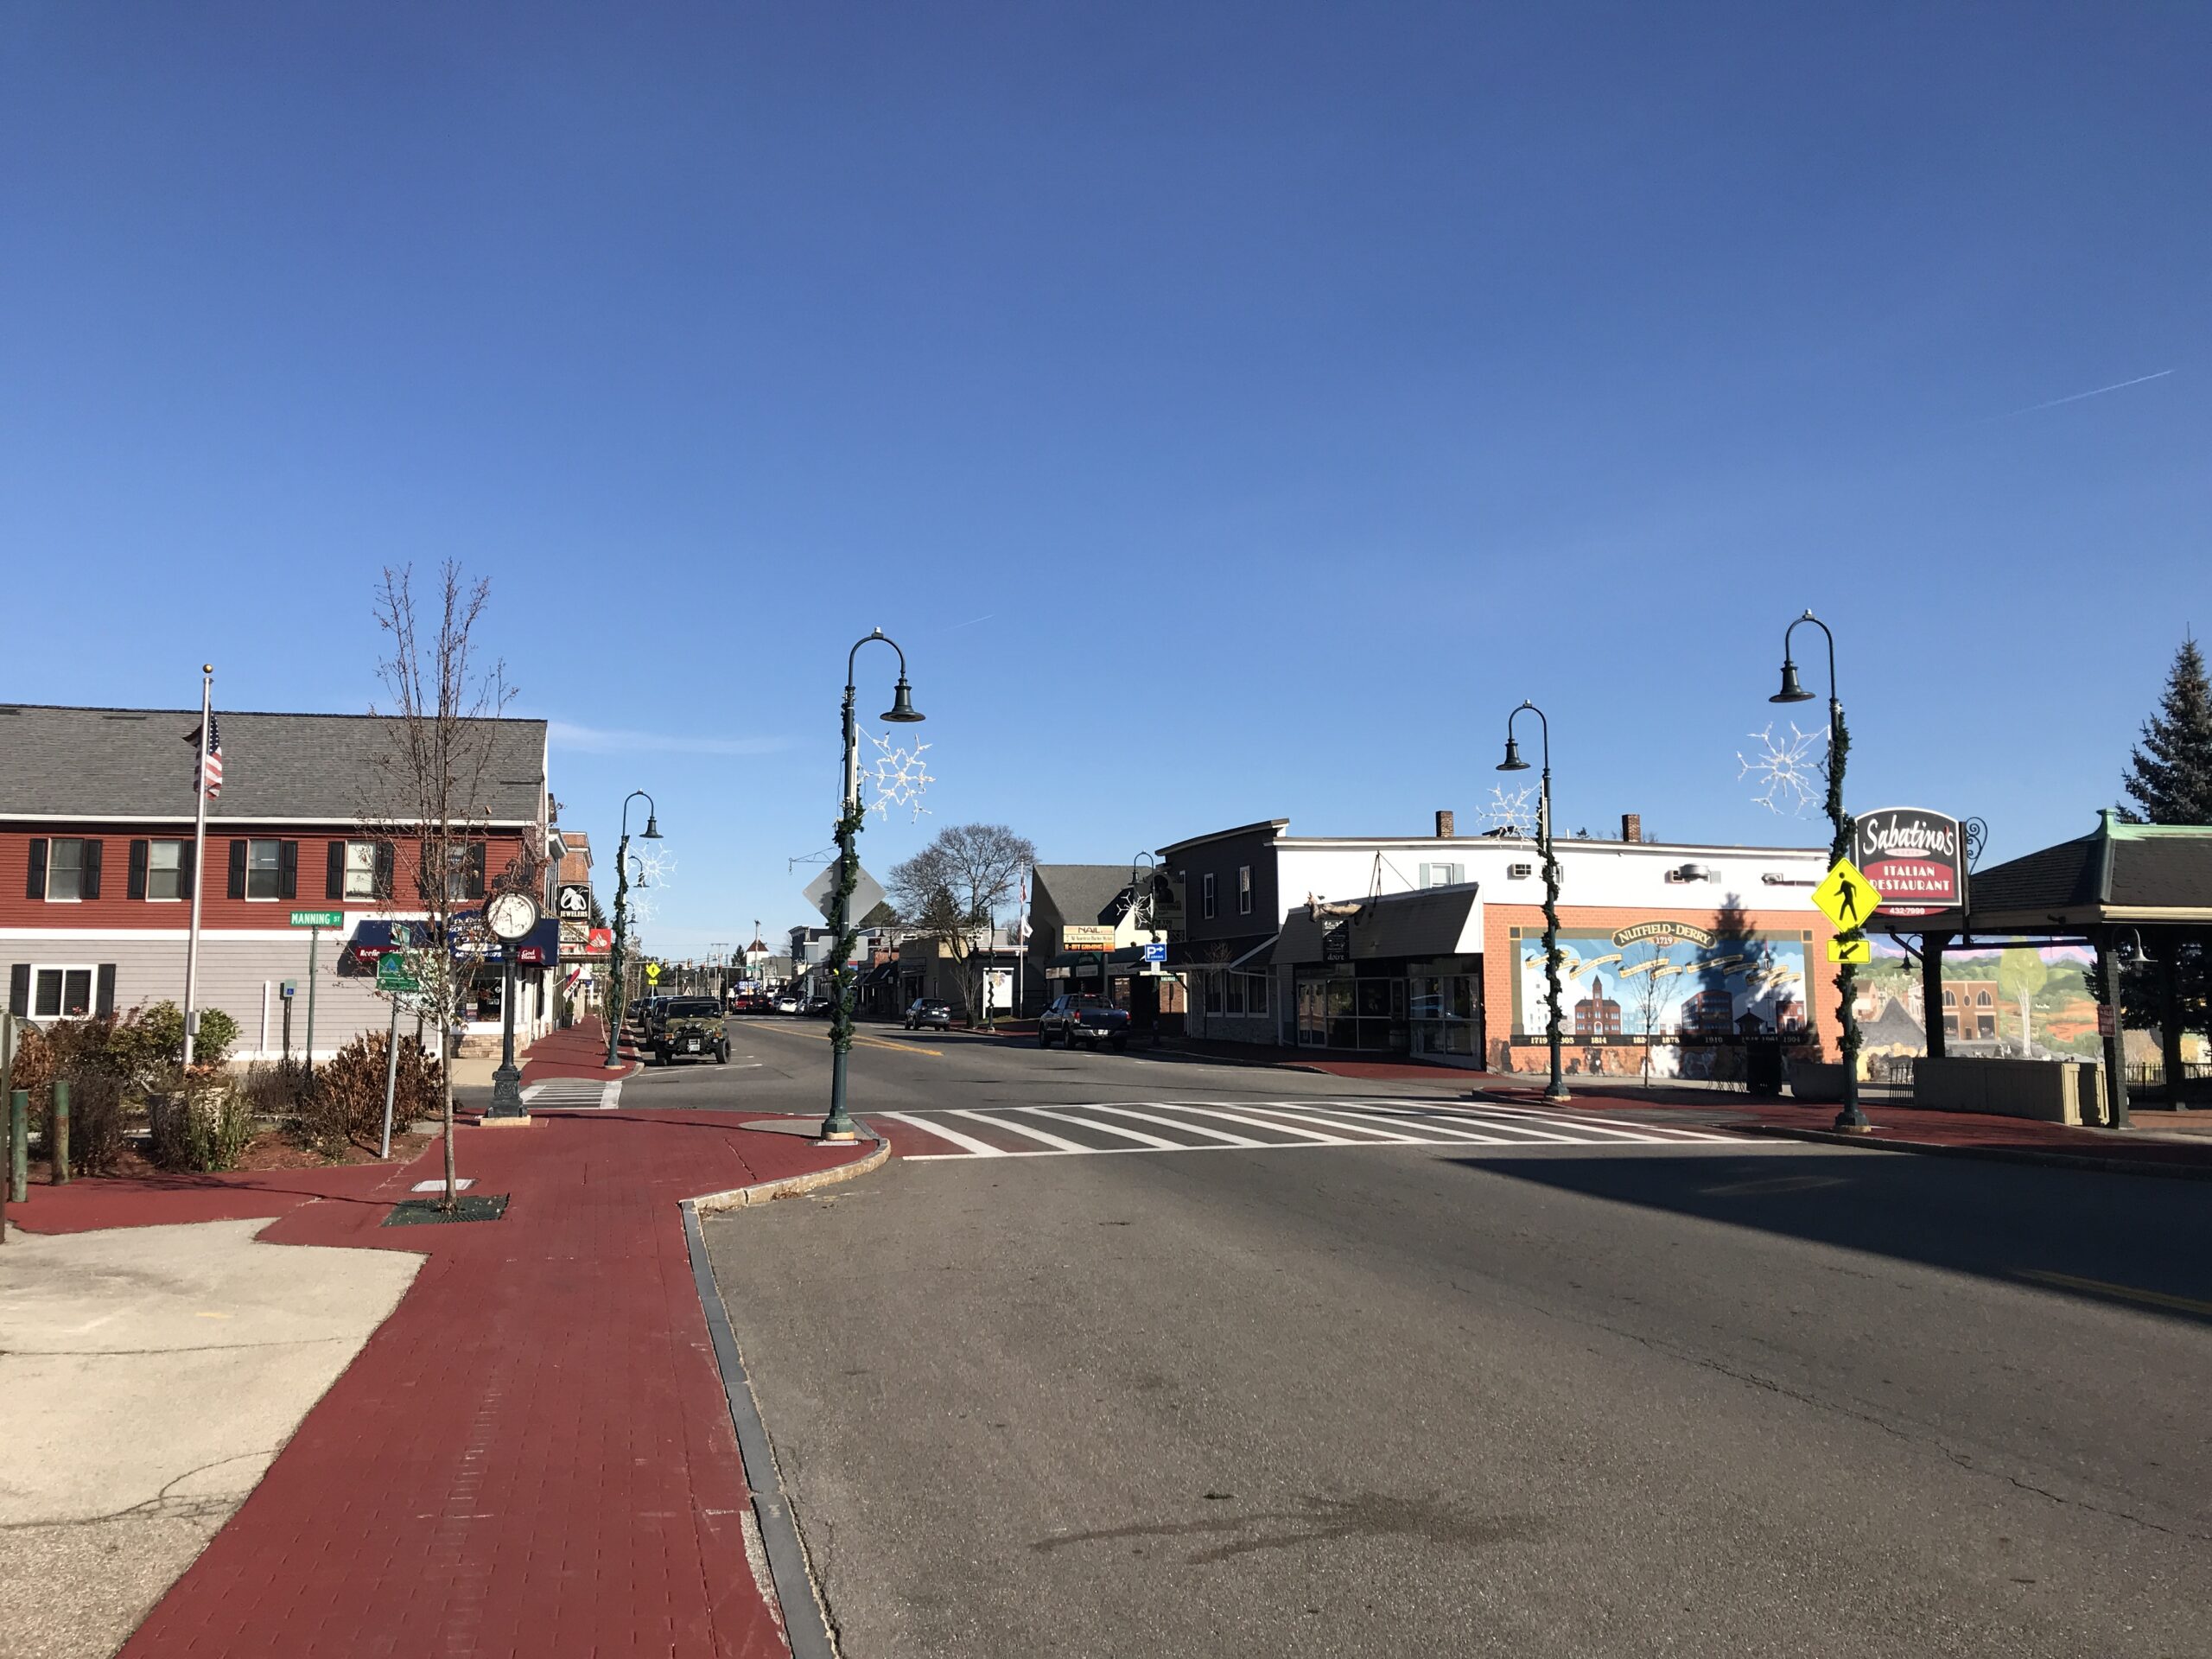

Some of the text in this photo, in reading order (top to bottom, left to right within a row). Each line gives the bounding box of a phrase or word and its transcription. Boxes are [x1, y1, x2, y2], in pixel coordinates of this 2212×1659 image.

[1862, 814, 1954, 856] Sabatino's
[1884, 865, 1935, 877] ITALIAN
[1869, 879, 1949, 891] RESTAURANT
[290, 912, 330, 925] MANNING
[1656, 936, 1674, 944] 1719
